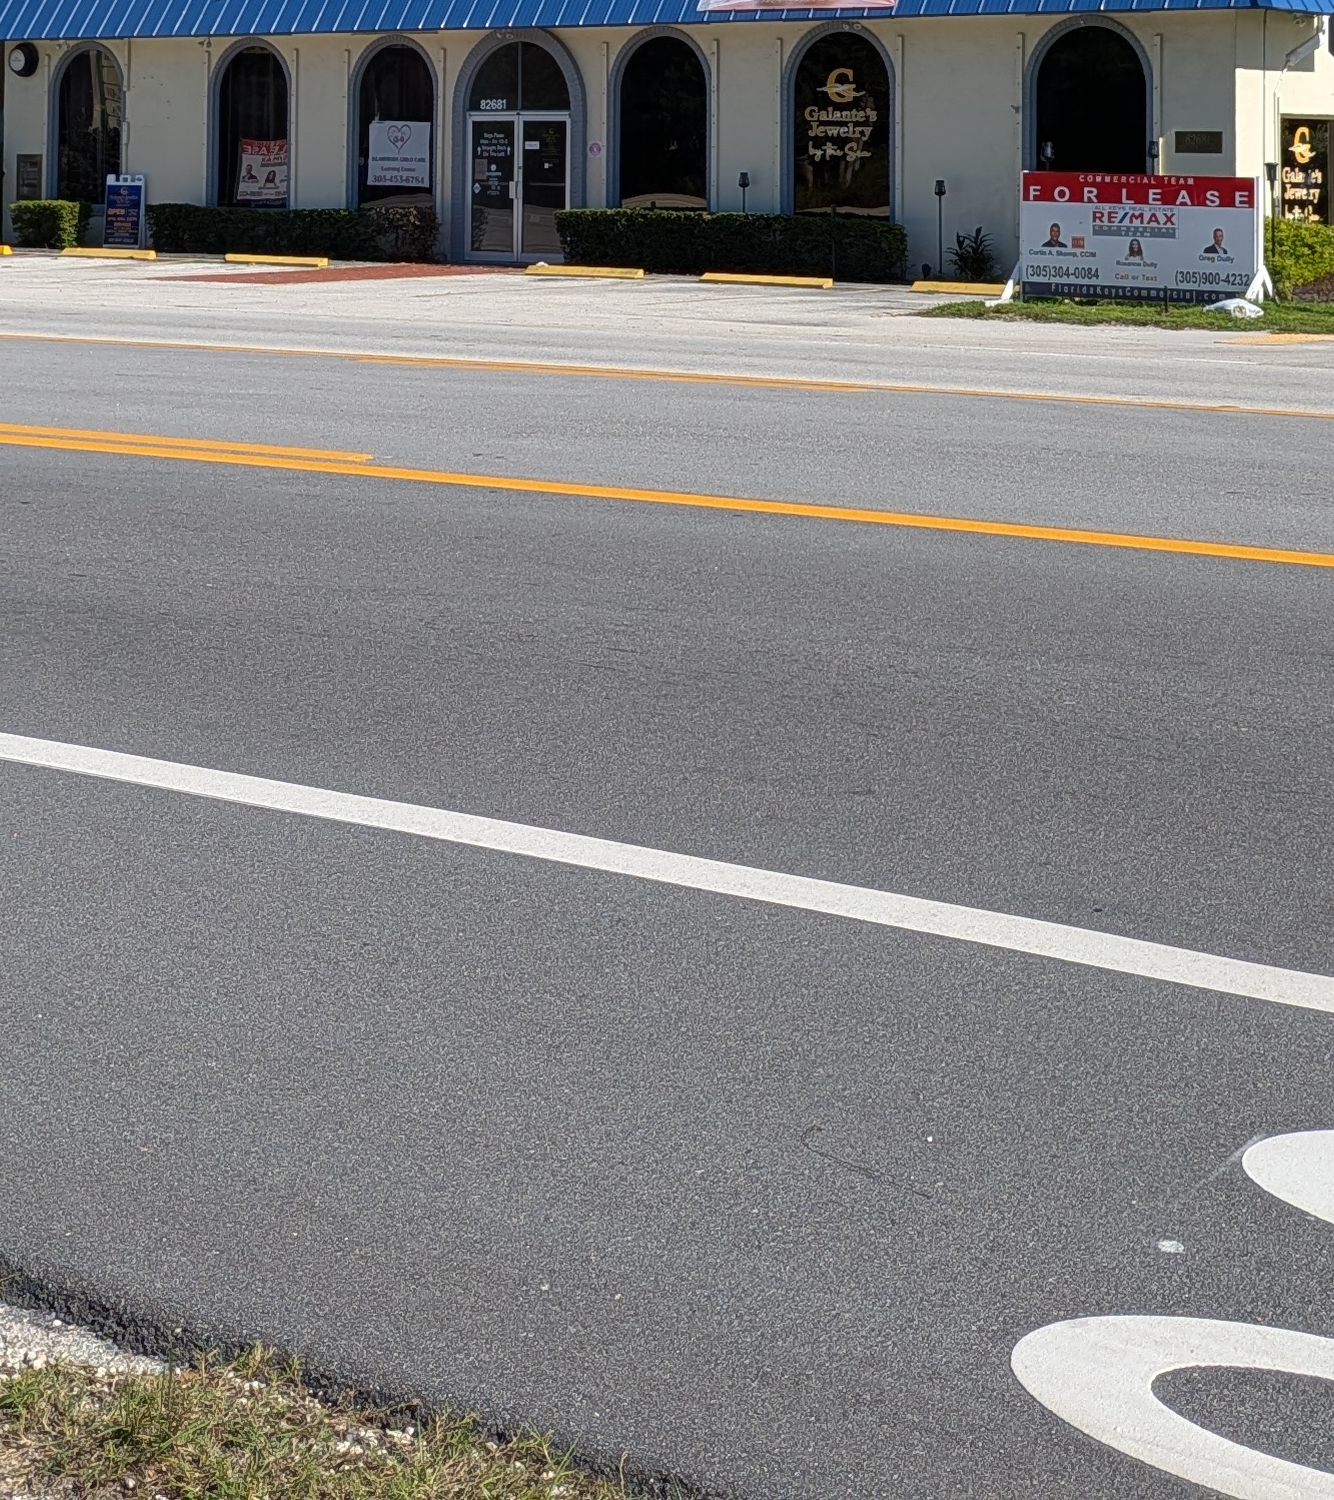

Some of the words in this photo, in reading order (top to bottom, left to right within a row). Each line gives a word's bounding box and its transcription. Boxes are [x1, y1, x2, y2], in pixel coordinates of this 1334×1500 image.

[827, 67, 856, 102] G
[480, 99, 507, 109] 82681
[804, 106, 877, 121] Galante's
[808, 122, 873, 140] Jewelry
[808, 141, 824, 161] by
[1079, 175, 1156, 184] COMMERCIAL
[1164, 177, 1194, 185] TEAM
[1029, 186, 1098, 203] FOR
[1121, 188, 1249, 207] LEASE
[1092, 210, 1175, 226] RE/MAX
[1199, 255, 1215, 263] Greg
[1026, 264, 1099, 280] (305)304-0084
[1175, 270, 1250, 287] (305)900-4232
